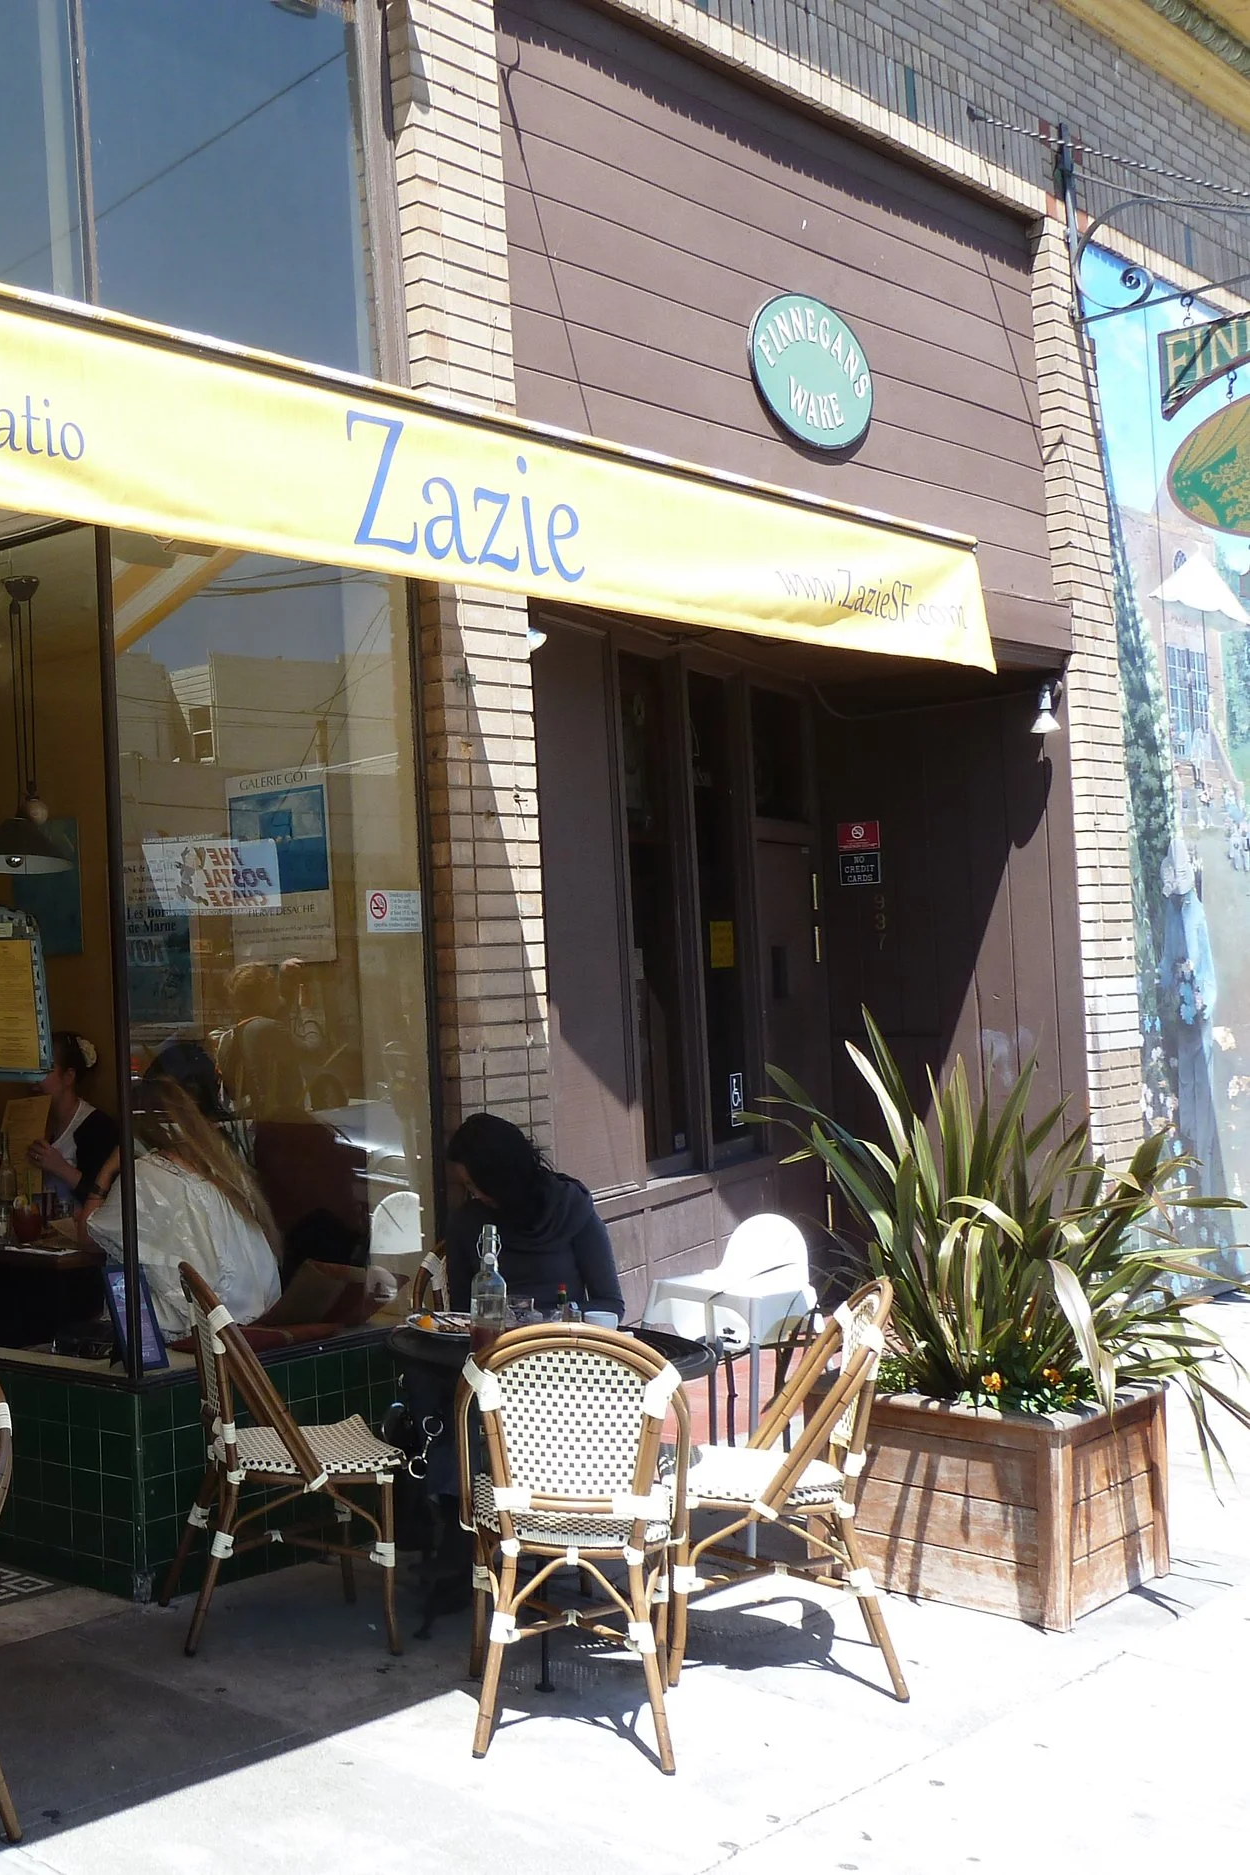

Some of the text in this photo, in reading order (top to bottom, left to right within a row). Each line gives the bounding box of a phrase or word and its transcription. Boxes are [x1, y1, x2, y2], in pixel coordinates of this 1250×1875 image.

[757, 306, 870, 399] FINNEGANS
[788, 374, 845, 431] WAKE
[345, 409, 586, 583] Zazie
[239, 771, 308, 791] GALERIE GOT
[853, 855, 865, 864] NO
[844, 864, 875, 874] CREDIT
[847, 873, 873, 883] CARDS
[128, 919, 177, 934] de Marne
